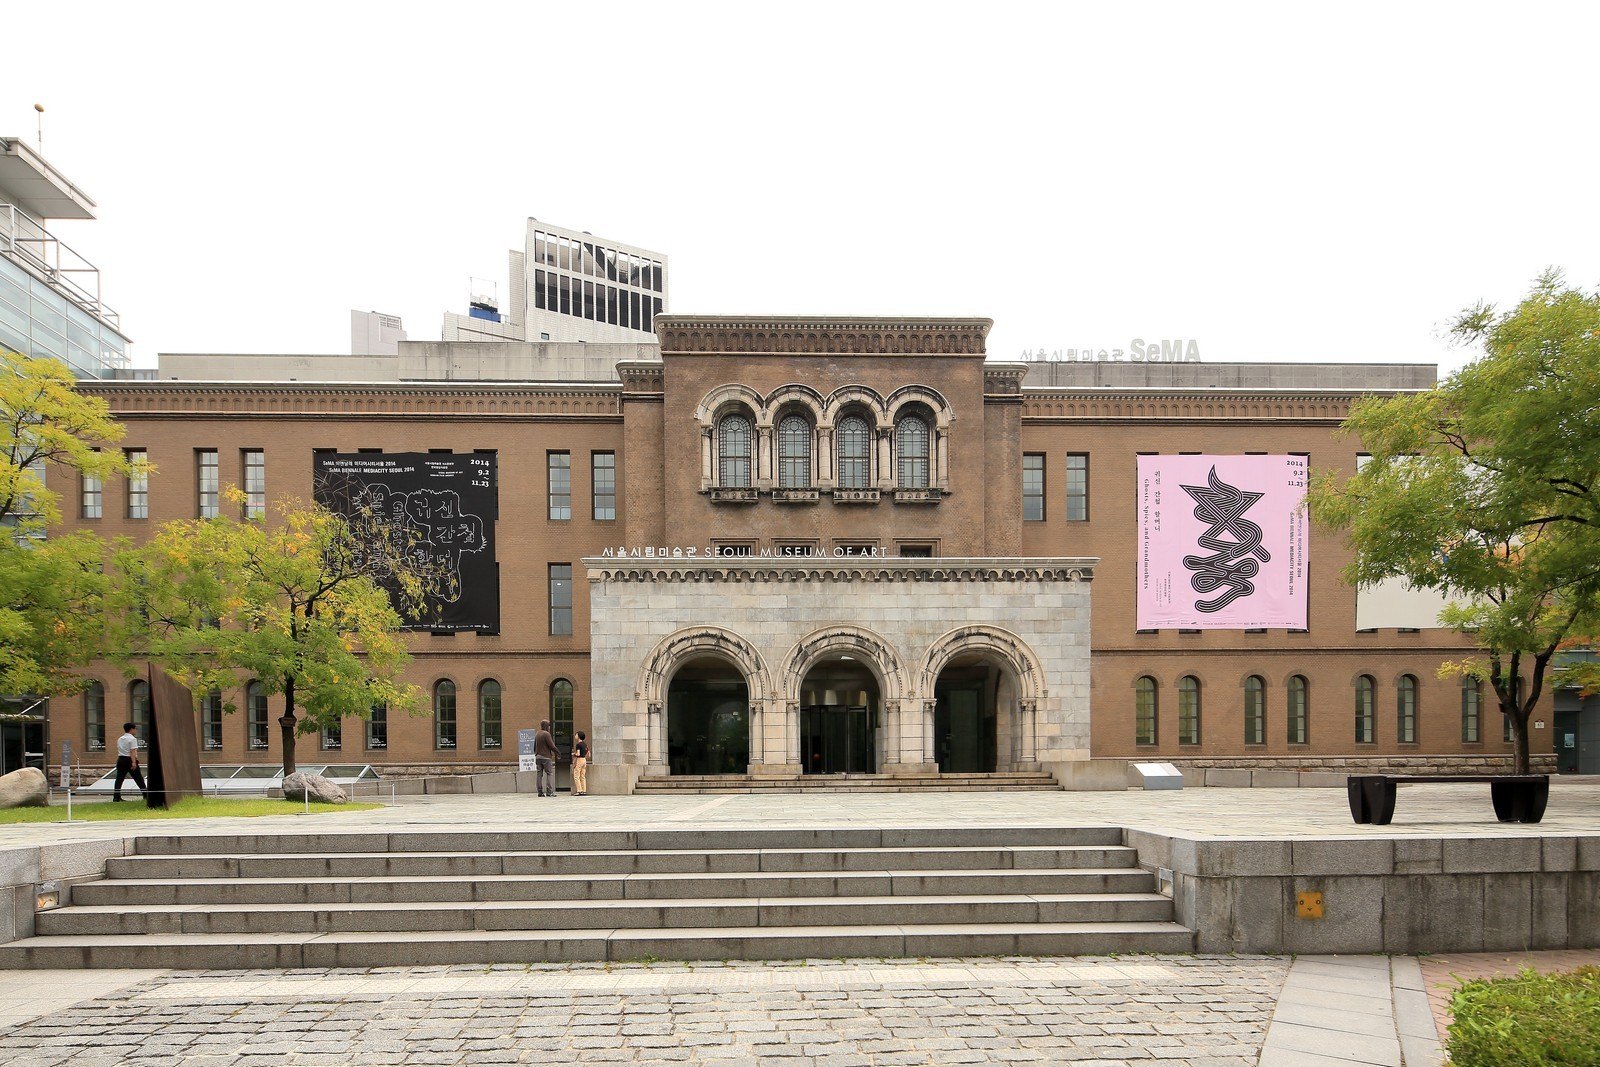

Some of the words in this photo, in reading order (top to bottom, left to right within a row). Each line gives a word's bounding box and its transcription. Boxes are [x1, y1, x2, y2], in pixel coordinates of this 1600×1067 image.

[1020, 348, 1124, 362] 서울시립미술관
[1130, 338, 1201, 362] SeMA
[602, 546, 697, 558] 서울시립미술관
[704, 547, 753, 558] SEOUL
[760, 547, 826, 558] MUSEUM
[833, 547, 852, 558] OF
[860, 547, 887, 558] ART
